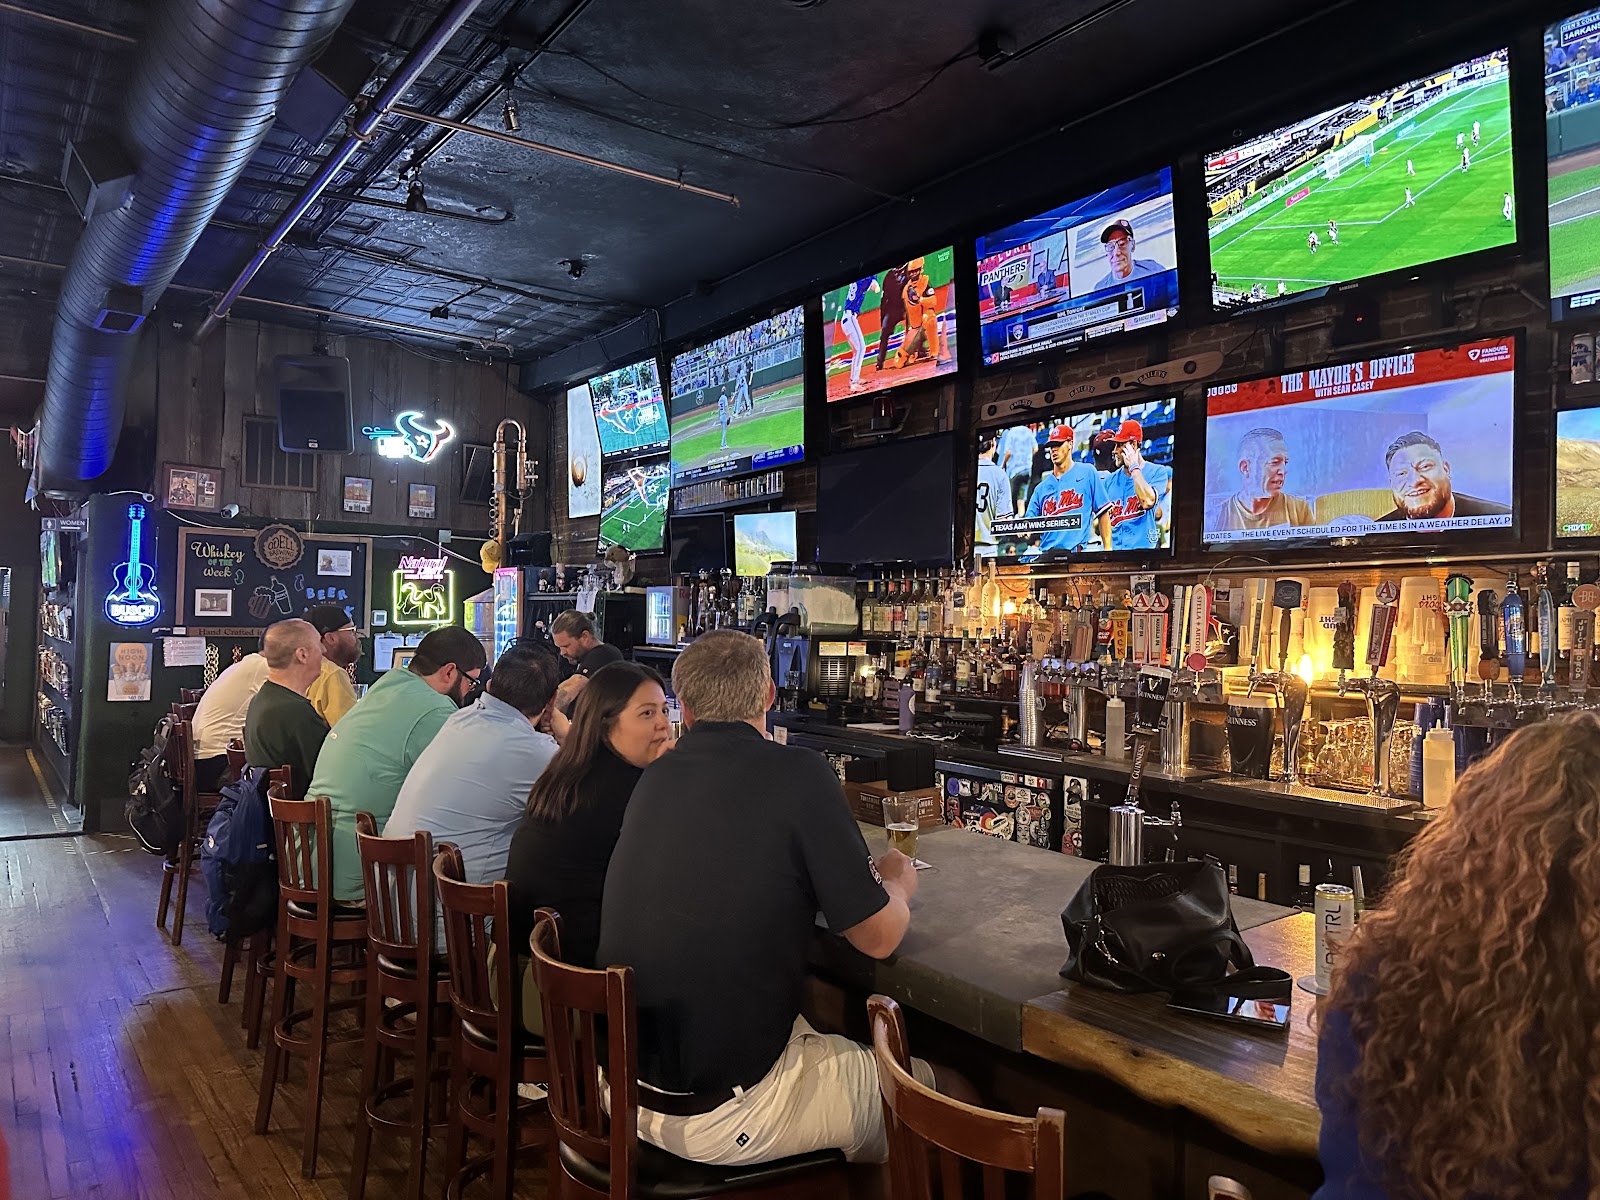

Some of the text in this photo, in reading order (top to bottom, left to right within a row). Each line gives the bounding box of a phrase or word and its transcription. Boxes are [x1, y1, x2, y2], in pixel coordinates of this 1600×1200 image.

[983, 260, 1026, 284] PANTHERS
[1137, 370, 1167, 383] BAILEYS
[1281, 353, 1415, 394] THE MAYOR'S OFFICE
[1068, 385, 1096, 398] BAILEYS
[1315, 380, 1375, 398] WITH SEAN CASEY
[995, 517, 1080, 532] TEXAS A&M WINS SERIES, 2-1
[1241, 530, 1254, 538] THE
[1255, 529, 1271, 537] LIVE
[1272, 528, 1296, 537] EVENT
[1296, 525, 1341, 536] SCHEDULED
[1341, 524, 1357, 533] FOR
[1358, 523, 1376, 532] THIS
[1378, 522, 1398, 531] TIME
[1400, 521, 1408, 530] IS
[1408, 520, 1417, 529] IN
[1418, 520, 1425, 528] A
[1426, 518, 1469, 528] WEATHER
[1471, 517, 1503, 526] DELAY.
[267, 534, 295, 551] ODELL
[191, 541, 246, 564] Whiskey
[207, 558, 218, 566] OF
[203, 566, 233, 578] Week
[306, 587, 349, 601] BEER
[1378, 580, 1393, 599] A
[1134, 592, 1149, 608] A
[1151, 591, 1165, 608] A
[110, 604, 155, 617] BUSCH
[199, 628, 222, 637] Hand
[224, 628, 255, 637] Crafted
[1116, 620, 1125, 656] BOCK
[1138, 690, 1165, 701] GUINNESS
[1227, 716, 1258, 727] GUINNESS
[1132, 744, 1145, 780] GUINNESS
